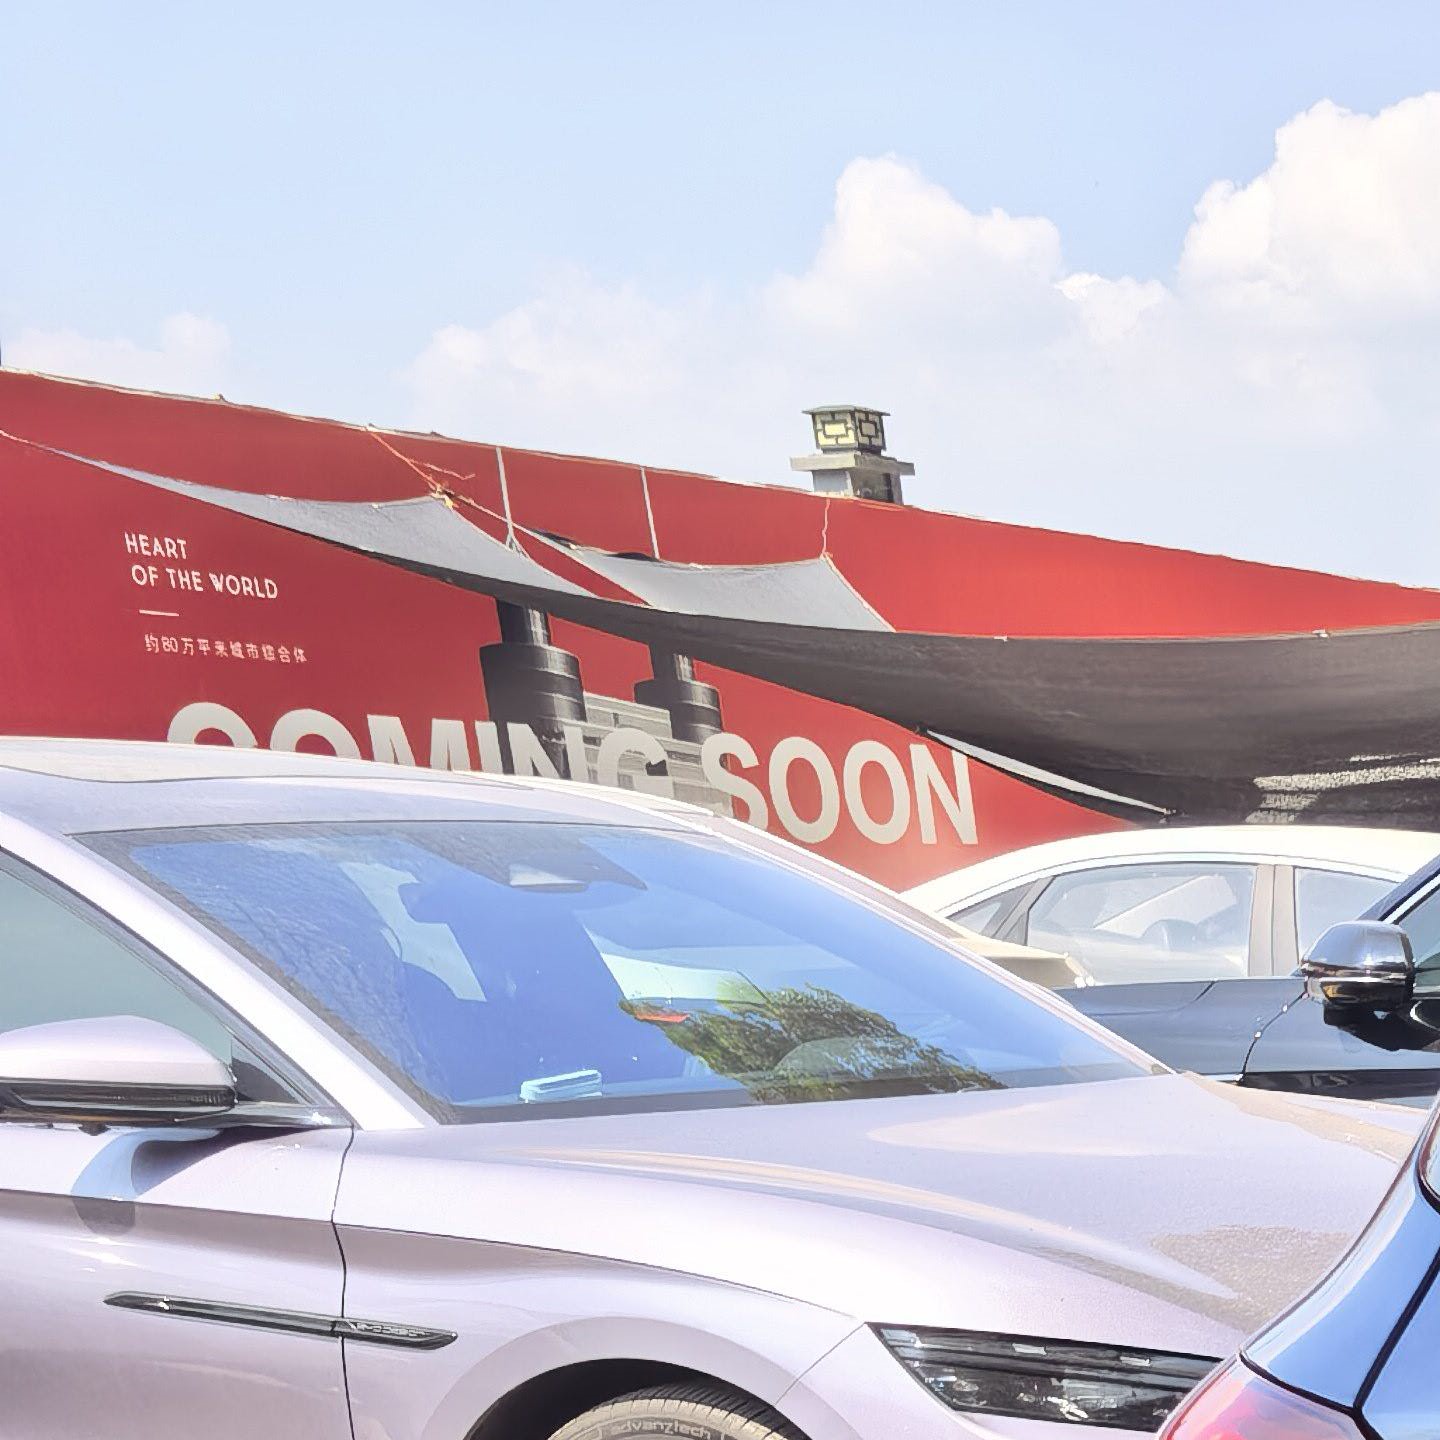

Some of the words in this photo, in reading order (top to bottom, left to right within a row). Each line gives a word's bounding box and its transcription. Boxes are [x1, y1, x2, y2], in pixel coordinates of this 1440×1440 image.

[124, 531, 187, 560] HEART
[131, 564, 159, 587] OF
[165, 567, 204, 592] THE
[208, 572, 278, 599] WORLD
[701, 732, 978, 846] SOON
